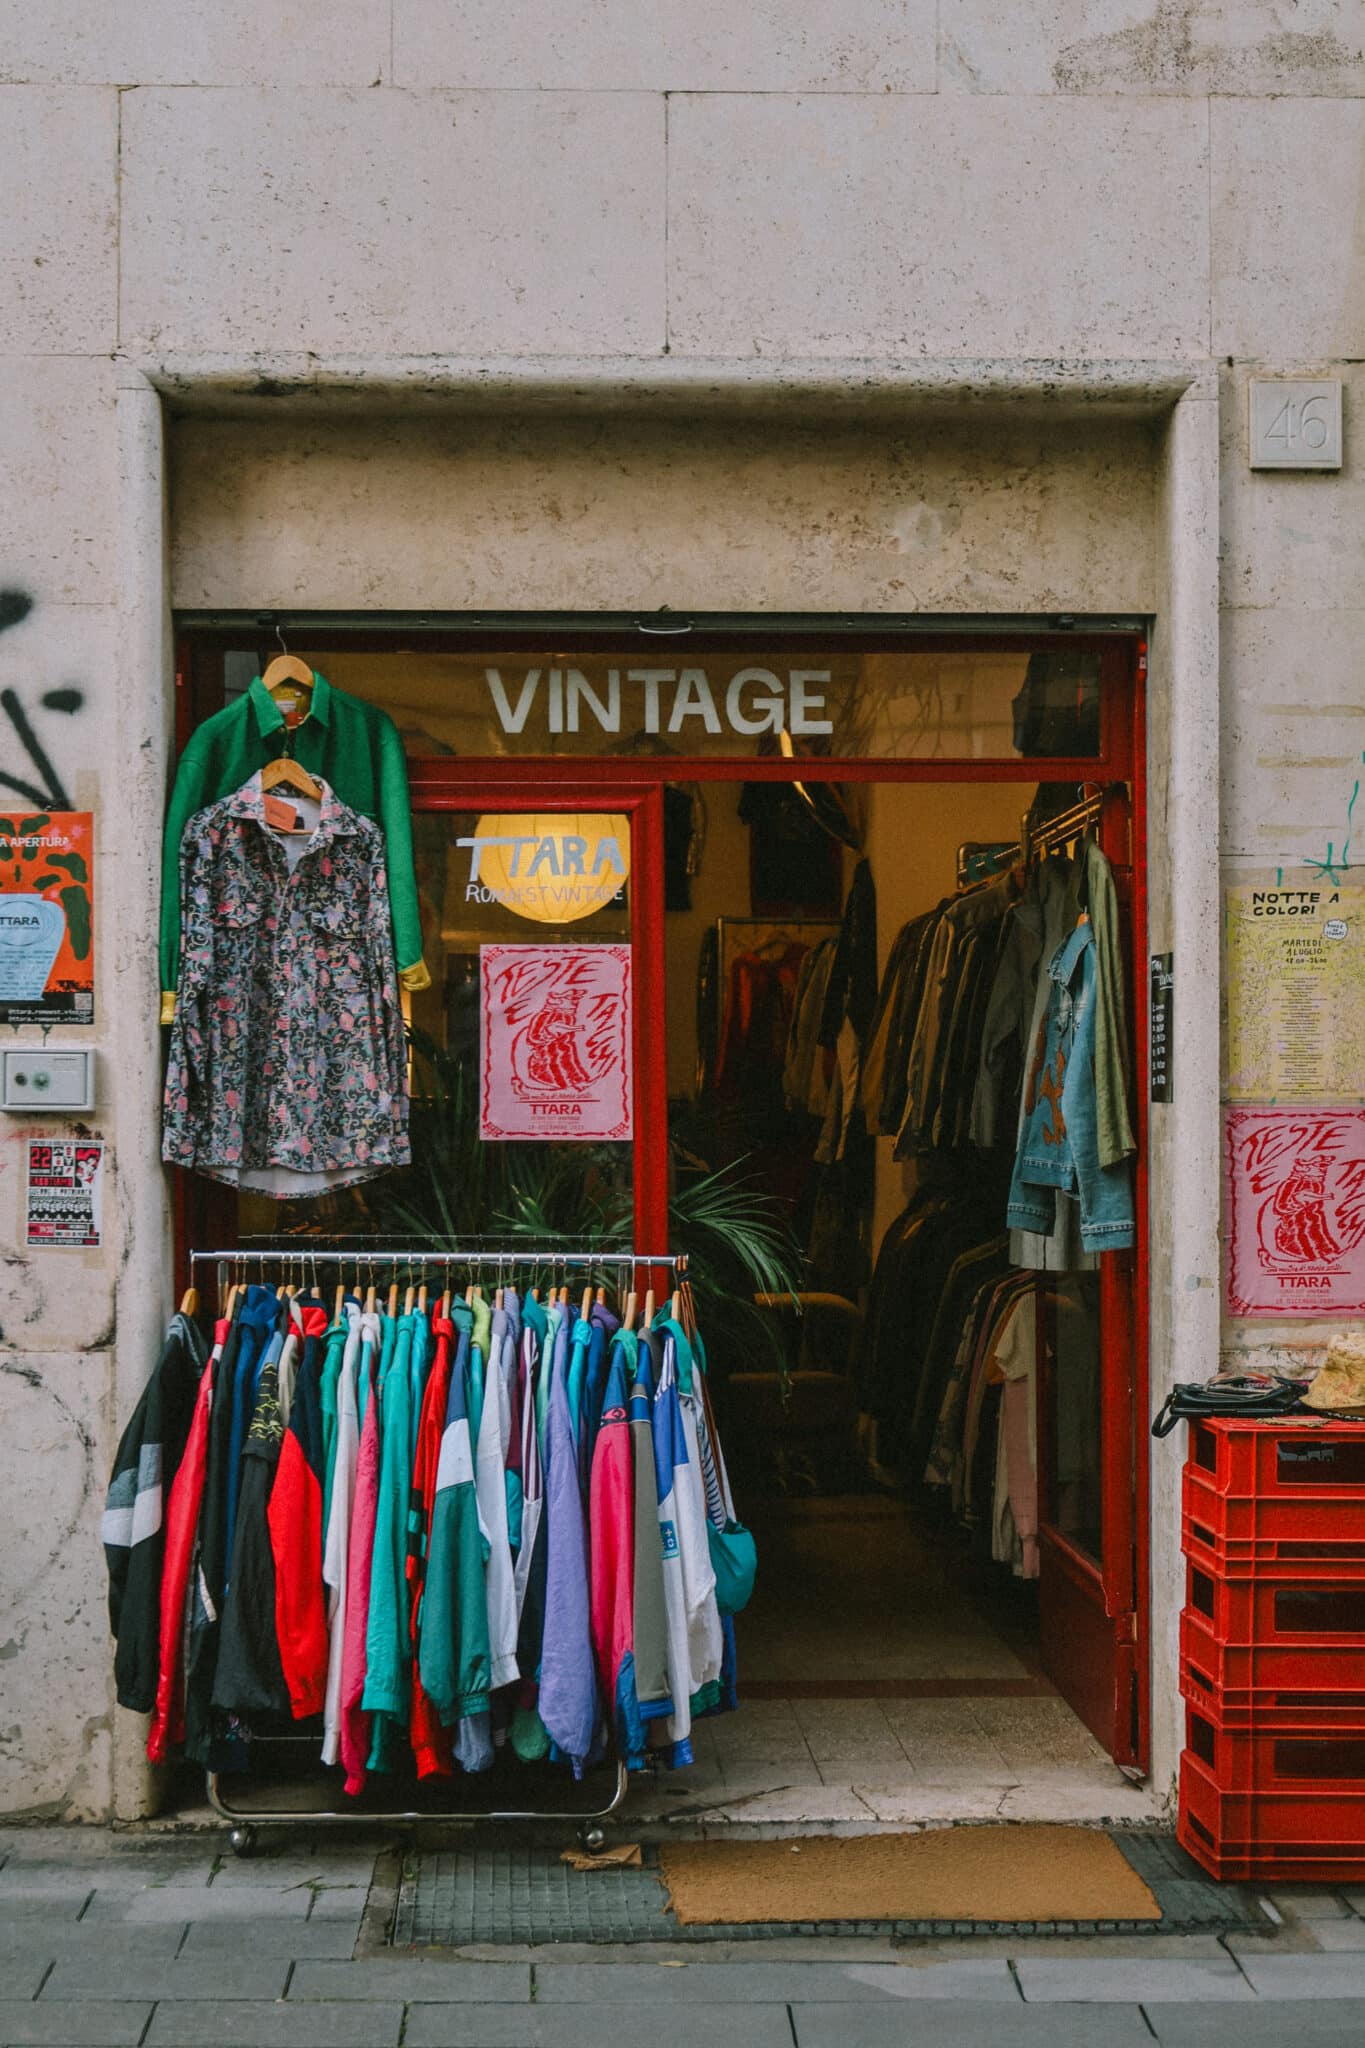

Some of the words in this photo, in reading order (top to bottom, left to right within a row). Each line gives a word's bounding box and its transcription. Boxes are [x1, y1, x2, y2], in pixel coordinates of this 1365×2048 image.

[1263, 395, 1328, 449] 46
[484, 667, 833, 735] VINTAGE
[10, 836, 69, 848] APERTURA
[456, 835, 627, 882] TTARA
[551, 884, 624, 903] VINTAGE
[1252, 891, 1321, 905] NOTTE
[1328, 892, 1340, 904] A
[1252, 905, 1316, 917] COLORI
[494, 956, 603, 1004] TESTE
[504, 998, 533, 1026] E
[529, 1104, 583, 1115] TTARA
[31, 1147, 52, 1169] 22
[1238, 1120, 1352, 1172] TESTE
[1249, 1165, 1281, 1194] E
[1277, 1276, 1332, 1288] TTARA
